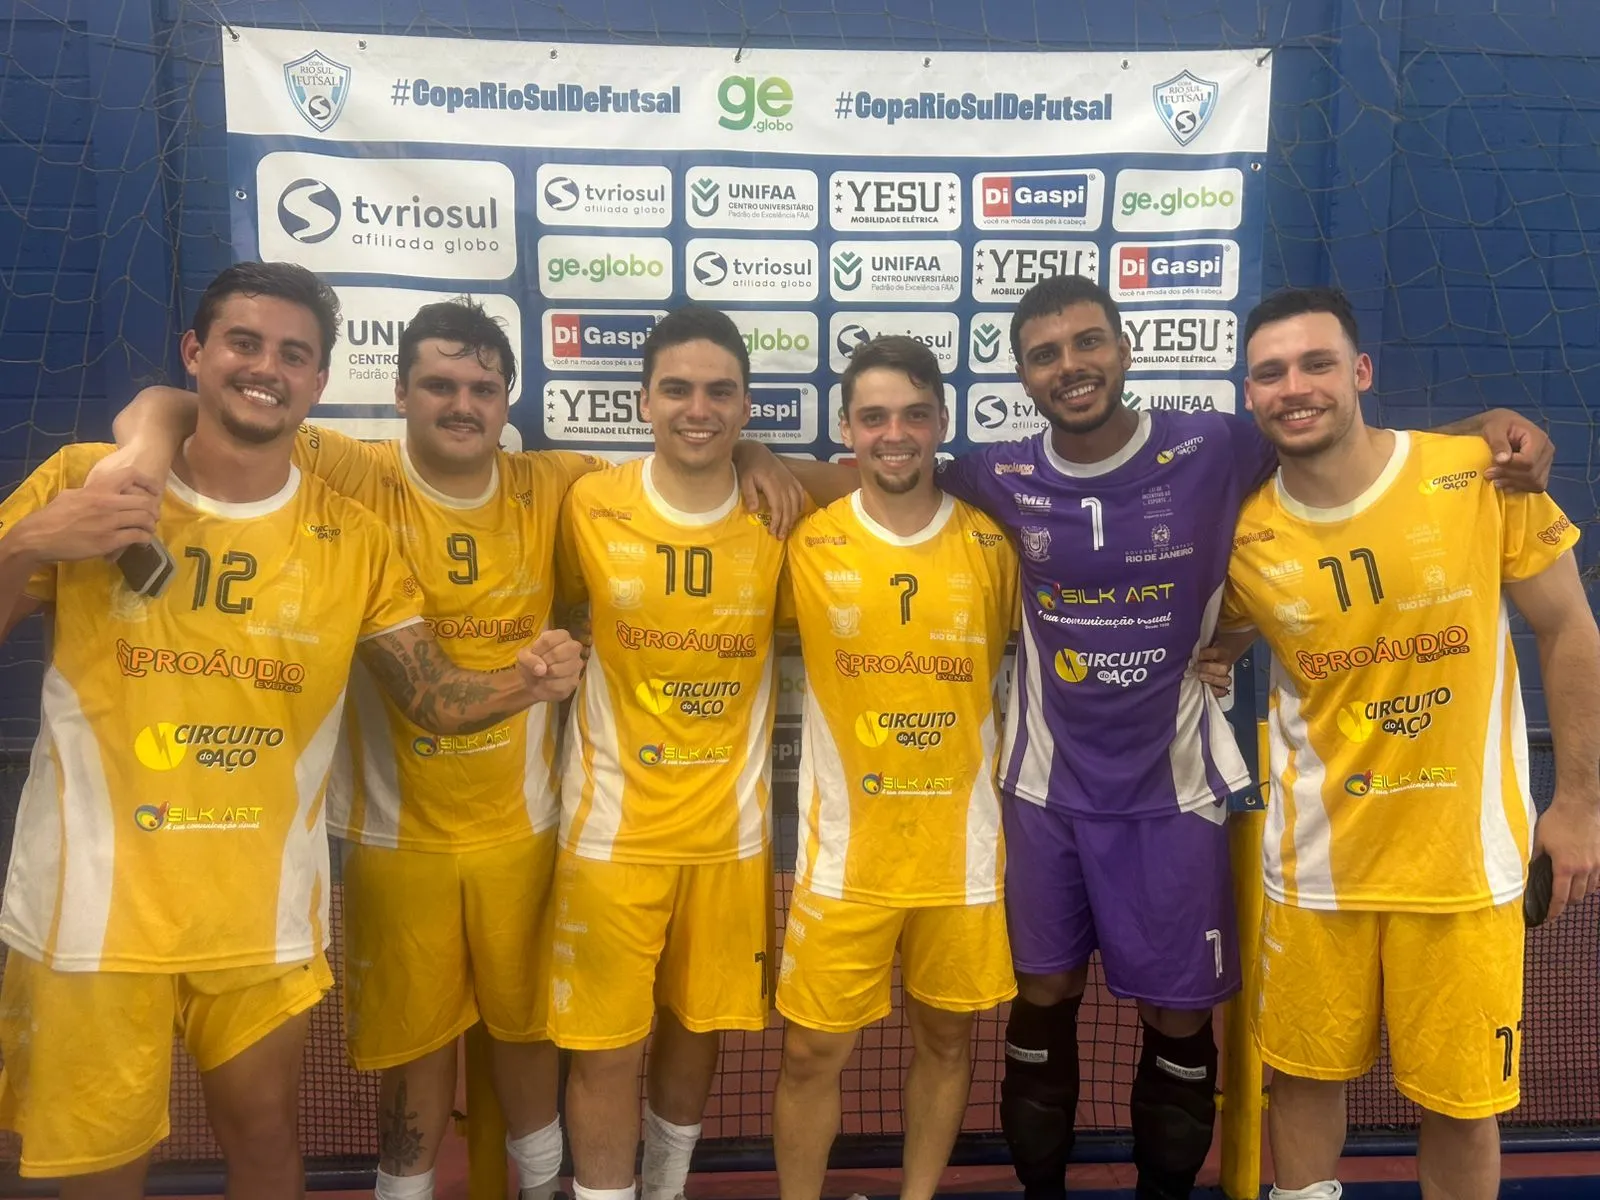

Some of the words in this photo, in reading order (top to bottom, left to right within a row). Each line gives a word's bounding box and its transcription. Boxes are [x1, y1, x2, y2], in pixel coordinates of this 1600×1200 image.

[300, 66, 316, 74] RIO
[317, 66, 334, 74] SUL
[296, 76, 338, 86] FUTSAL
[1168, 86, 1185, 94] RIO
[1186, 85, 1202, 94] SUL
[390, 78, 681, 113] #CopaRioSulDeFutsal
[717, 74, 794, 131] ge
[1164, 93, 1208, 104] FUTSAL
[834, 90, 1113, 125] #CopaRioSulDeFutsal
[584, 184, 666, 202] tvriosul
[728, 183, 796, 200] UNIFAA
[847, 181, 942, 213] YESU
[985, 186, 1009, 205] Di
[1014, 184, 1085, 208] Gaspi
[1121, 186, 1234, 216] ge.globo
[352, 196, 498, 230] tvriosul
[584, 204, 628, 214] afiliada
[634, 205, 666, 216] globo
[728, 202, 758, 210] CENTRO
[758, 202, 814, 212] UNIVERSITÁRIO
[851, 216, 902, 224] MOBILIDADE
[902, 214, 939, 224] ELÉTRICA
[1044, 218, 1056, 226] pés
[1062, 218, 1086, 227] cabeça
[352, 232, 434, 252] afiliada
[444, 238, 499, 254] globo
[547, 253, 664, 283] ge.globo
[733, 258, 812, 276] tvriosul
[871, 256, 941, 272] UNIFAA
[990, 249, 1083, 283] YESU
[1122, 258, 1145, 276] Di
[1152, 256, 1220, 278] Gaspi
[732, 279, 776, 288] afiliada
[781, 280, 812, 288] globo
[871, 275, 902, 283] CENTRO
[902, 274, 959, 284] UNIVERSITÁRIO
[895, 284, 904, 292] de
[942, 284, 954, 292] FAA
[991, 288, 1025, 296] MOBILID
[554, 326, 578, 344] Di
[1125, 318, 1220, 352] YESU
[552, 358, 570, 366] você
[580, 358, 600, 366] moda
[615, 358, 626, 368] pés
[1182, 355, 1216, 363] ELÉTRICA
[349, 369, 388, 380] Padrão
[750, 400, 798, 420] aspi
[1150, 396, 1215, 410] UNIFAA
[564, 426, 616, 434] MOBILIDADE
[618, 426, 654, 435] ELÉTRICA
[1432, 470, 1478, 486] CIRCUITO
[1014, 492, 1052, 506] SMEL
[1080, 496, 1104, 551] 1
[446, 532, 478, 585] 9
[1126, 554, 1143, 563] RIO
[1144, 554, 1158, 562] DE
[1158, 547, 1194, 560] JANEIRO
[656, 544, 713, 598] 10
[1259, 559, 1304, 579] SMEL
[184, 546, 258, 614] 12
[1318, 548, 1384, 613] 11
[889, 573, 920, 626] 7
[1061, 587, 1116, 605] SILK
[1125, 582, 1175, 604] ART
[424, 615, 535, 639] ROÁUDIO
[1060, 615, 1134, 630] comunicação
[628, 628, 757, 653] PROÁUDIO
[1311, 626, 1468, 673] PROÁUDIO
[129, 647, 305, 684] PROÁUDIO
[849, 651, 974, 676] PROÁUDIO
[1076, 648, 1166, 668] CIRCUITO
[1108, 668, 1148, 687] AÇO
[662, 681, 742, 698] CIRCUITO
[690, 700, 724, 719] AÇO
[1364, 687, 1452, 720] CIRCUITO
[878, 711, 957, 729] CIRCUITO
[1394, 712, 1432, 738] AÇO
[174, 724, 284, 747] CIRCUITO
[440, 736, 479, 750] SILK
[486, 726, 510, 744] ART
[906, 731, 942, 750] AÇO
[211, 749, 257, 772] AÇO
[664, 746, 701, 760] SILK
[704, 745, 733, 760] ART
[883, 776, 918, 789] SILK
[924, 777, 954, 790] ART
[1372, 772, 1412, 788] SILK
[1418, 768, 1457, 780] ART
[166, 807, 215, 823] SILK
[222, 806, 264, 822] ART
[1205, 928, 1223, 978] 1
